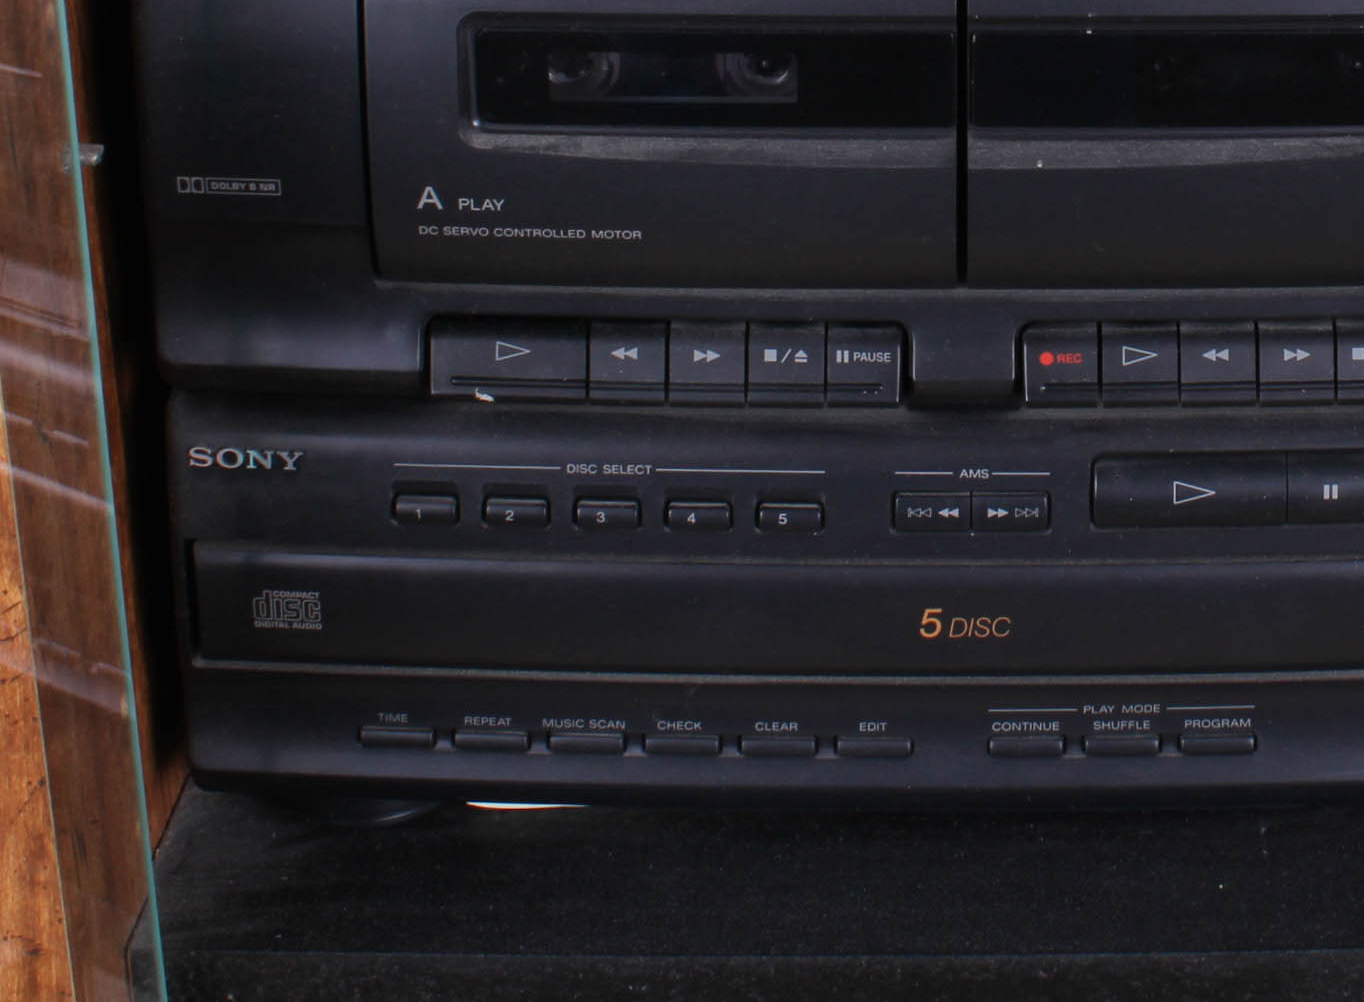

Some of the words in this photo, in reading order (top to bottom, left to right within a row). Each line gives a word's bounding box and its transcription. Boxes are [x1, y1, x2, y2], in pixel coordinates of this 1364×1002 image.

[417, 187, 442, 209] A
[459, 198, 504, 211] PLAY
[419, 226, 438, 235] DC
[443, 226, 489, 236] SERVO
[494, 228, 585, 238] CONTROLLED
[592, 230, 641, 239] MOTOR
[853, 352, 891, 362] PAUSE
[1056, 353, 1082, 363] REC
[189, 447, 303, 470] SONY
[567, 464, 597, 474] DISC
[603, 464, 652, 475] SELECT
[960, 469, 989, 478] AMS
[920, 608, 942, 637] 5
[949, 617, 1010, 637] DISC
[1083, 705, 1114, 714] PLAY
[1122, 704, 1160, 713] MODE
[464, 716, 511, 726] REPEAT
[543, 718, 584, 728] MUSIC
[589, 719, 625, 729] SCAN
[657, 721, 701, 730] CHECK
[1094, 720, 1150, 730] SHUFFLE
[1185, 718, 1251, 728] PROGRAM
[755, 722, 798, 731] CLEAR
[860, 722, 887, 731] EDIT
[992, 722, 1059, 731] CONTINUE
